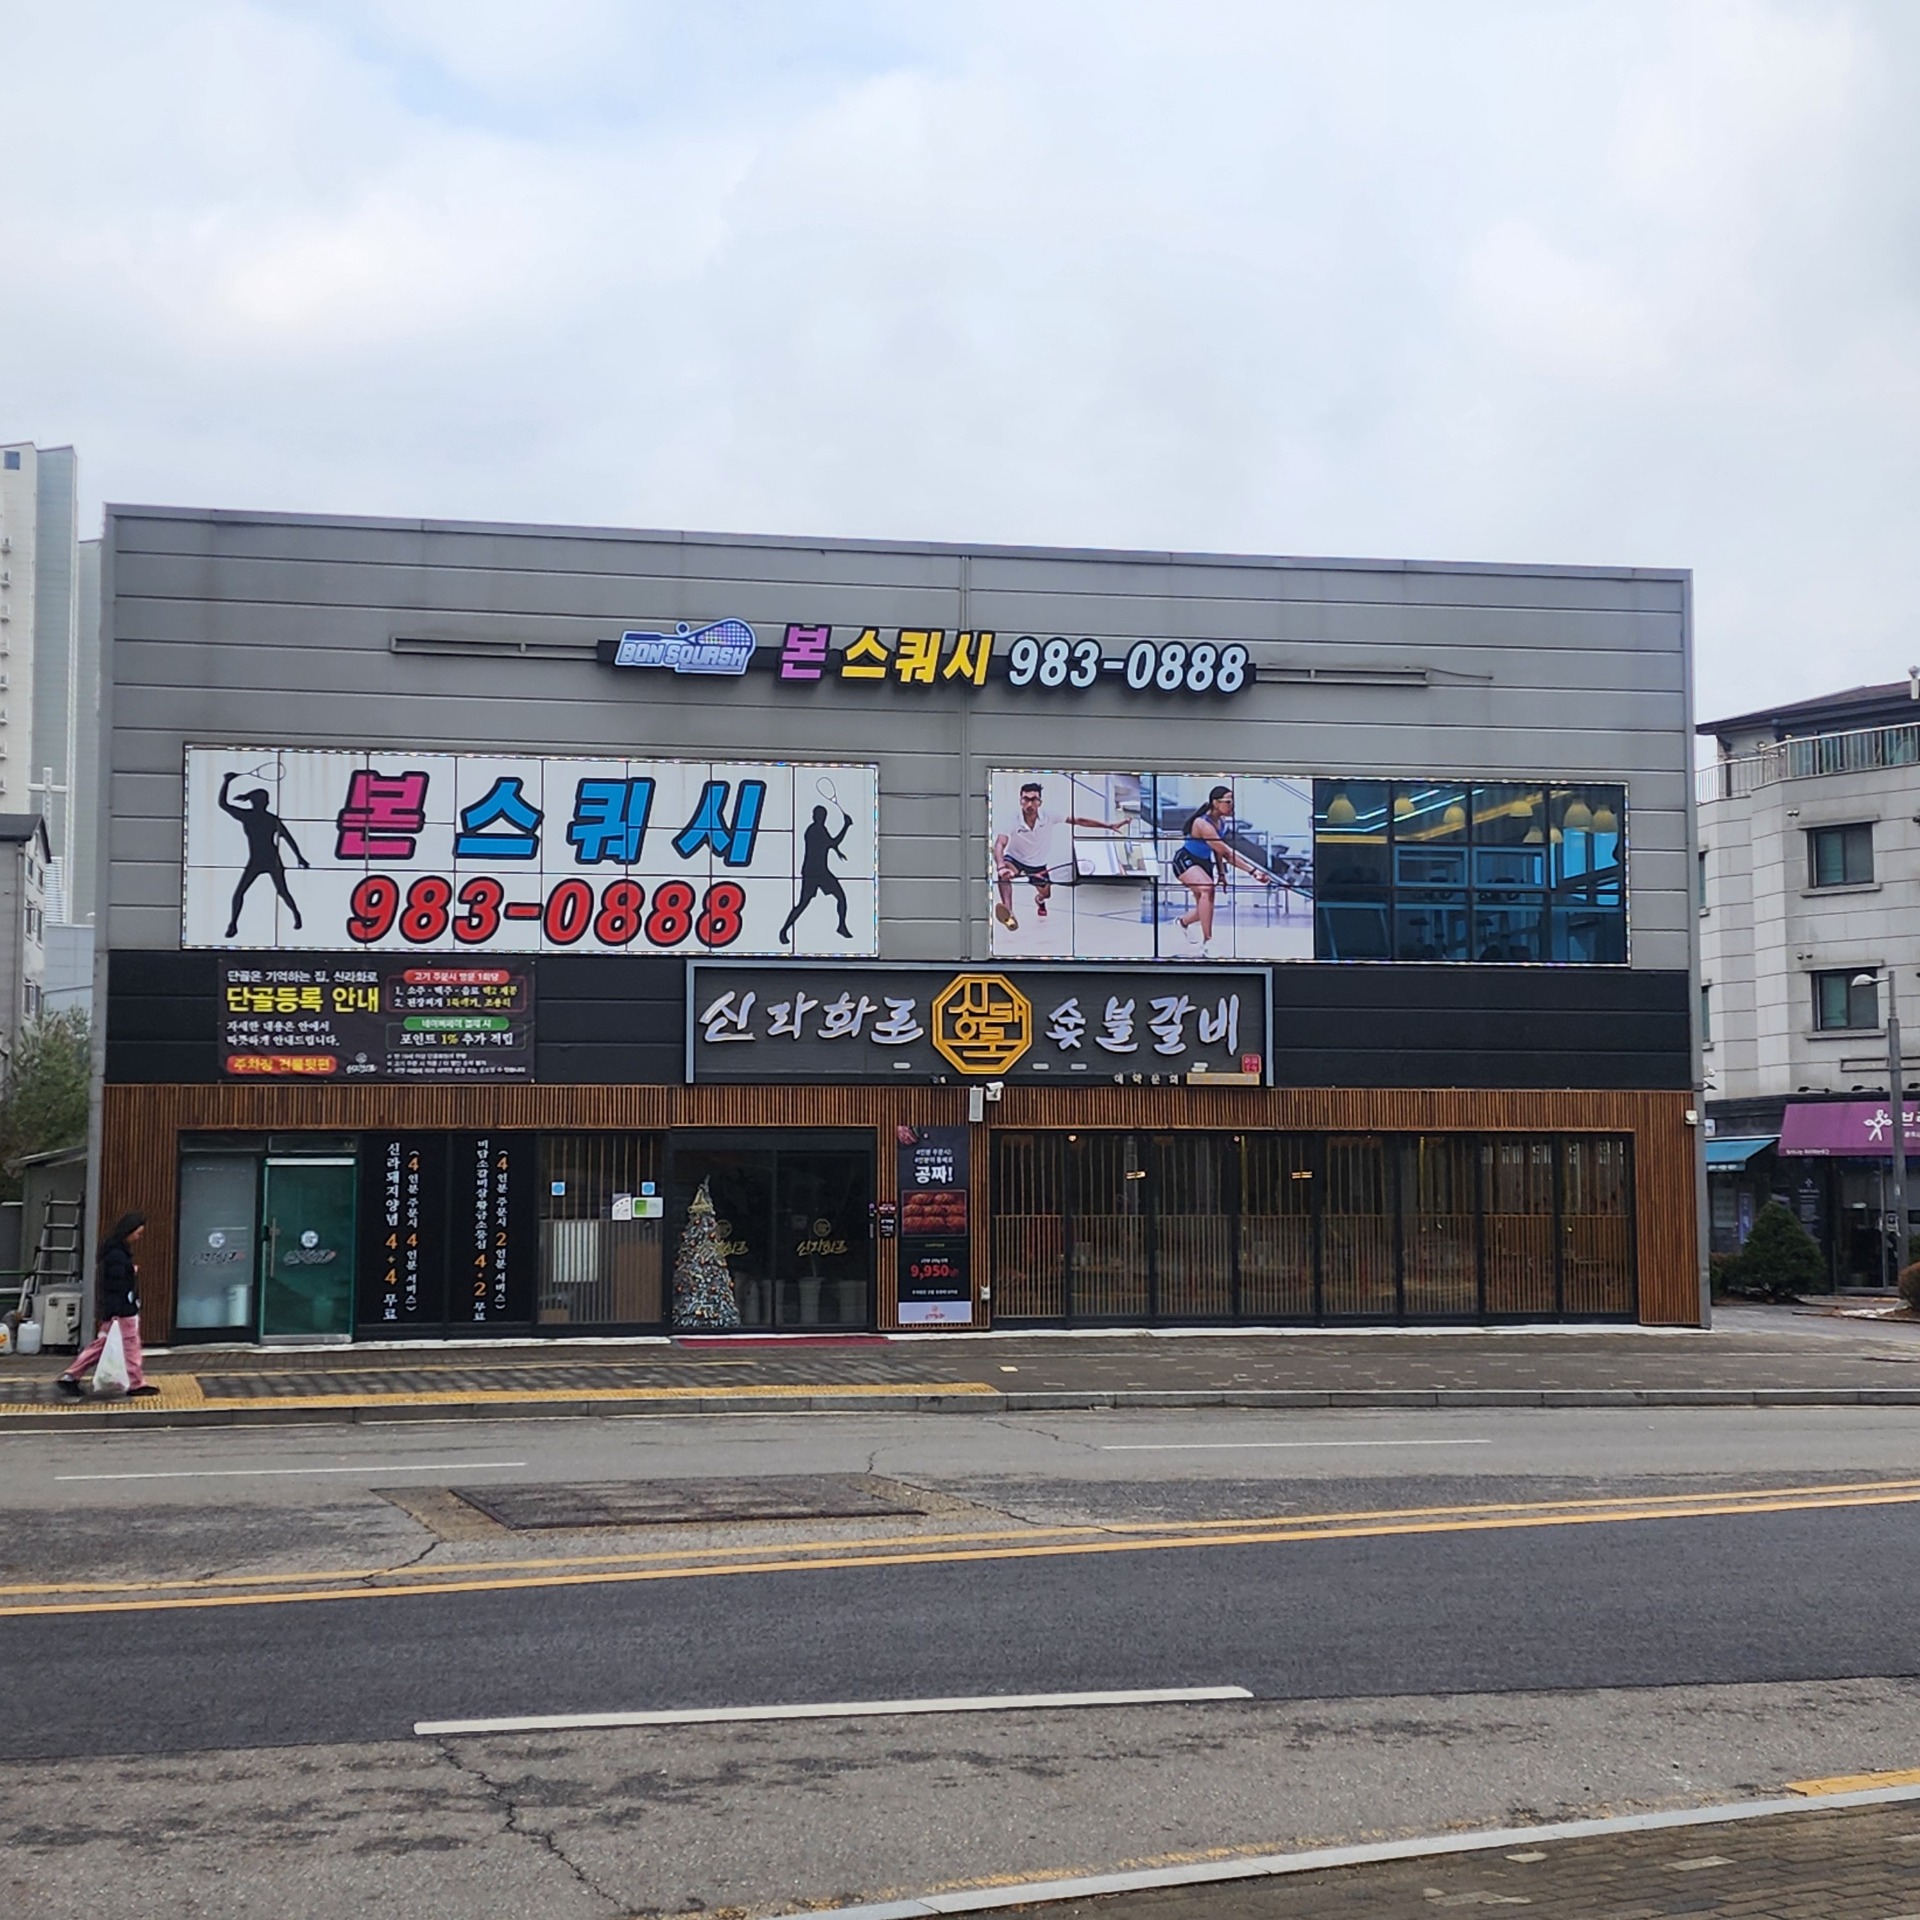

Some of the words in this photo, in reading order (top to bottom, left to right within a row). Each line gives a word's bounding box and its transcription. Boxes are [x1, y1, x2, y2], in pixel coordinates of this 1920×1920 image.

[619, 642, 664, 664] BON
[664, 644, 748, 666] SQUASH
[780, 626, 830, 679] 본
[841, 629, 994, 686] 스쿼시
[1008, 638, 1247, 692] 983-0888
[337, 772, 427, 857] 본
[454, 778, 764, 864] 스쿼시
[348, 876, 745, 946] 983-0888
[227, 970, 262, 983] 단골은
[265, 970, 311, 983] 기억하는
[333, 970, 379, 983] 신라화로
[226, 986, 324, 1013] 단골등록
[332, 986, 380, 1013] 안내
[227, 1020, 260, 1032] 자세한
[263, 1020, 295, 1032] 내용은
[298, 1020, 330, 1032] 안에서
[698, 990, 924, 1044] 신라화로
[1045, 993, 1240, 1056] 숯불갈비
[400, 1033, 437, 1046] 포인트
[441, 1033, 459, 1046] 1%
[461, 1032, 487, 1046] 추가
[490, 1032, 513, 1046] 적립
[234, 1058, 273, 1071] 주차장
[385, 1142, 401, 1226] 신라돼지양념
[915, 1165, 953, 1184] 공짜!
[406, 1197, 419, 1229] 주문시
[496, 1197, 508, 1228] 주문시
[382, 1293, 398, 1320] 무료
[473, 1302, 486, 1321] 무료
